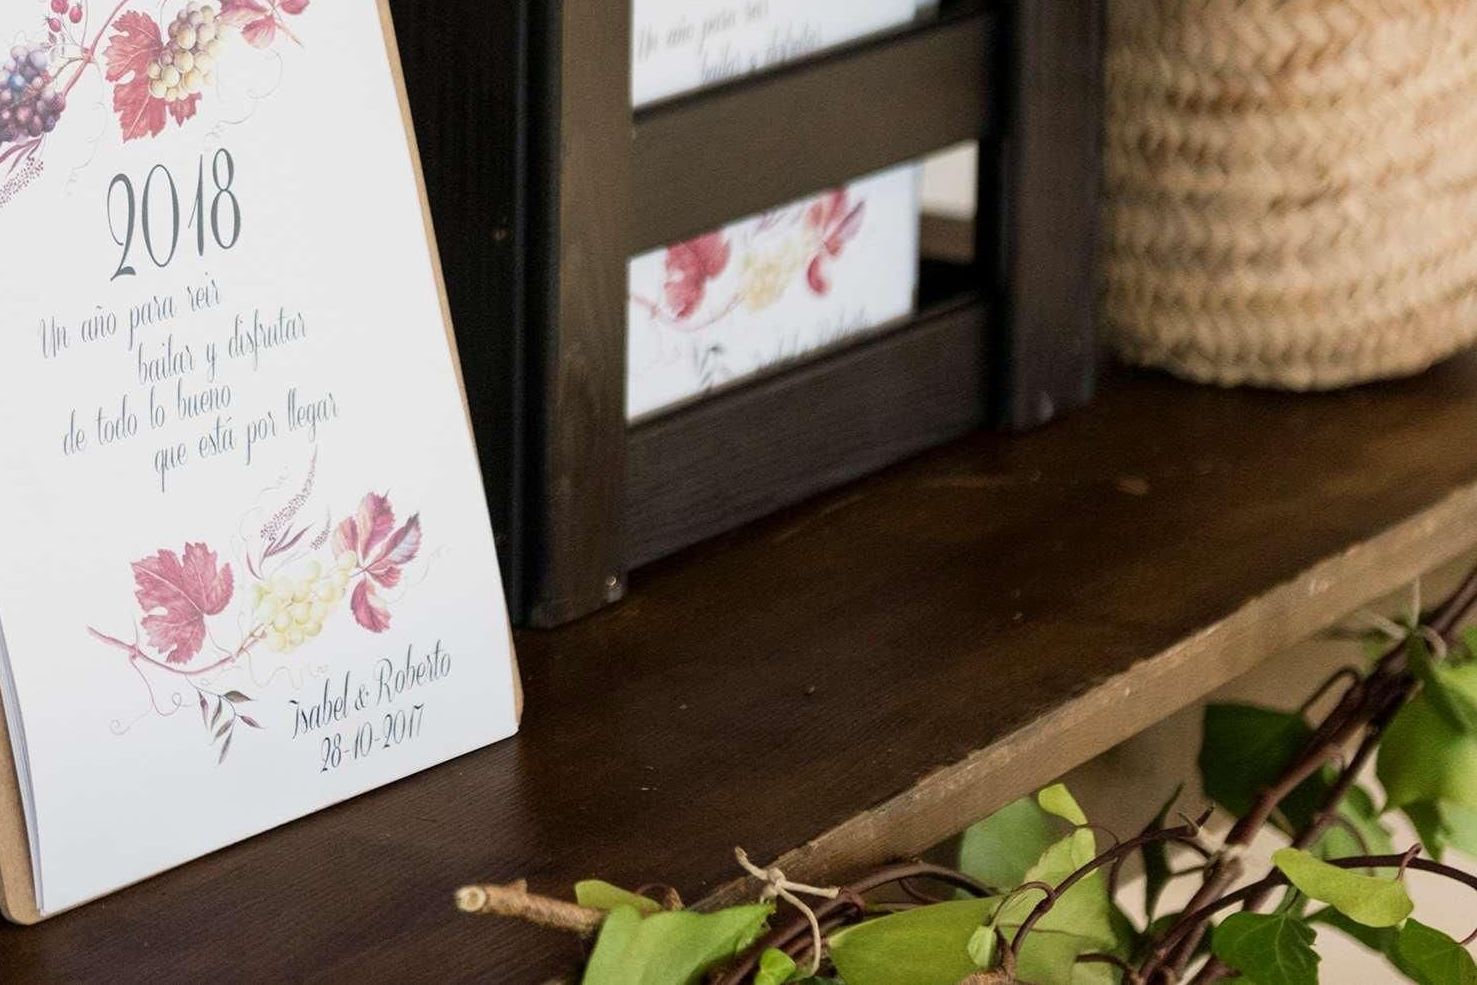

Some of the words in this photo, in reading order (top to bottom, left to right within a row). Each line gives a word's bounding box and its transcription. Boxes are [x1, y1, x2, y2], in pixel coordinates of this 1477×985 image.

[106, 147, 242, 282] 2018
[38, 316, 70, 359] Un
[80, 305, 117, 343] año
[128, 295, 178, 351] para
[137, 333, 196, 384] bailar
[205, 343, 218, 383] y
[227, 307, 308, 372] disfrutar
[62, 406, 86, 456] de
[97, 393, 139, 445] todo
[148, 385, 166, 430] lo
[176, 376, 232, 420] bueno
[153, 441, 188, 493] que
[198, 416, 237, 458] está
[244, 410, 278, 466] por
[286, 386, 340, 443] llegar
[288, 670, 351, 740] Isabel
[353, 683, 370, 711] &
[375, 639, 452, 706] Roberto
[319, 703, 425, 775] 28-10-2017
